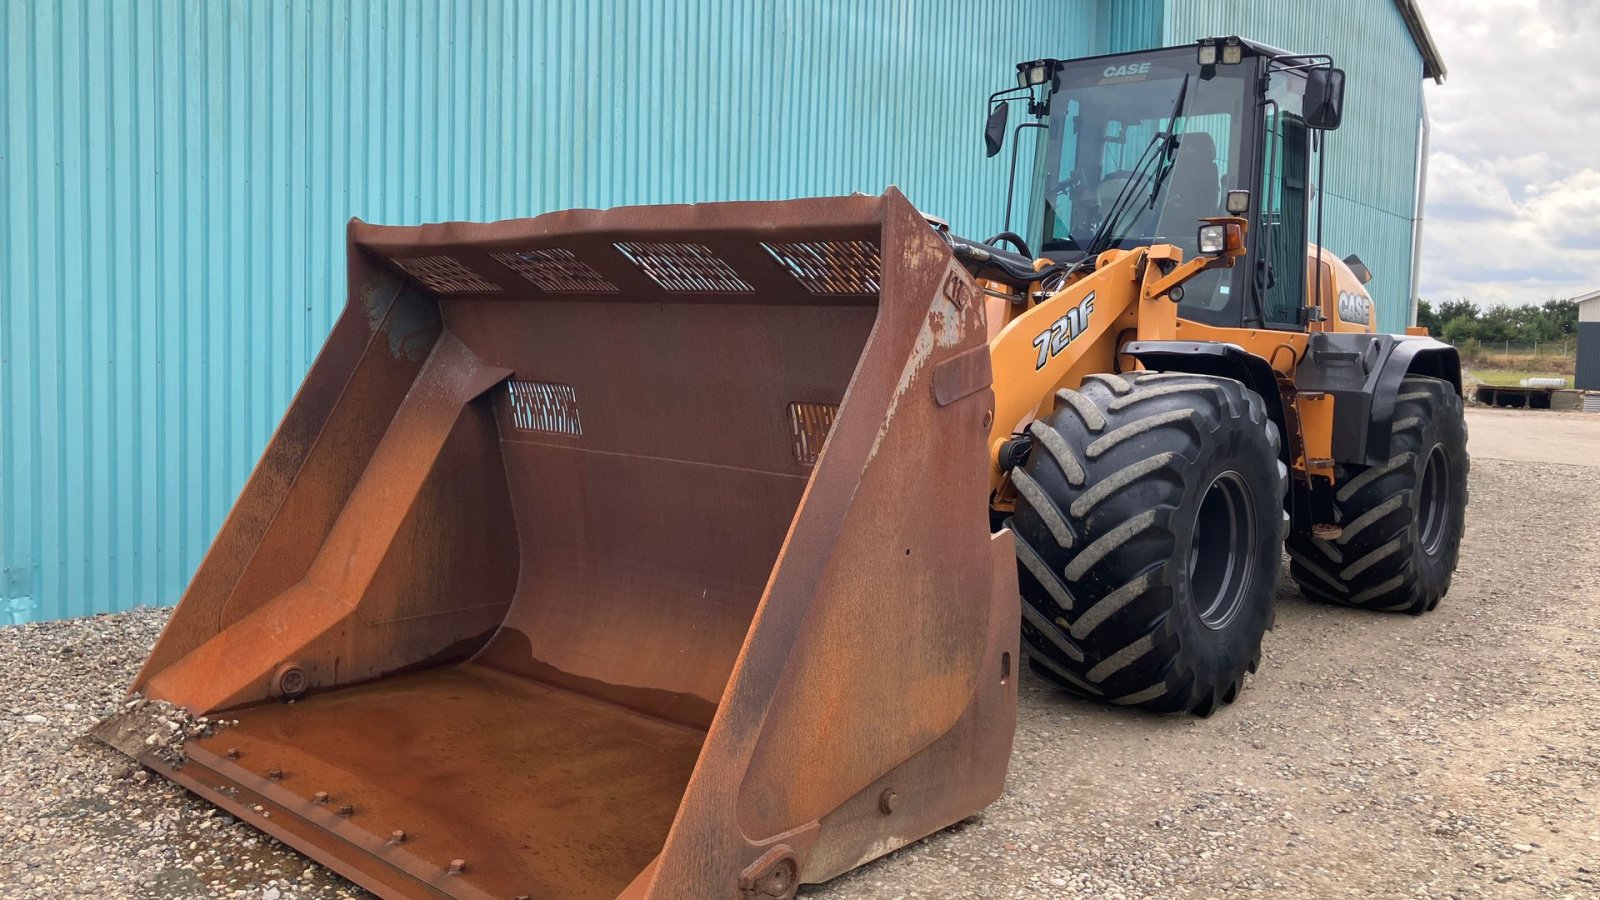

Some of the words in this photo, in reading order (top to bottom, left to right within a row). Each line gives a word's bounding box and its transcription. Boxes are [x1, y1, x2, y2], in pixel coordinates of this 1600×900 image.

[1103, 62, 1152, 78] CASE
[1338, 290, 1369, 326] CASE
[1033, 290, 1096, 371] 721F
